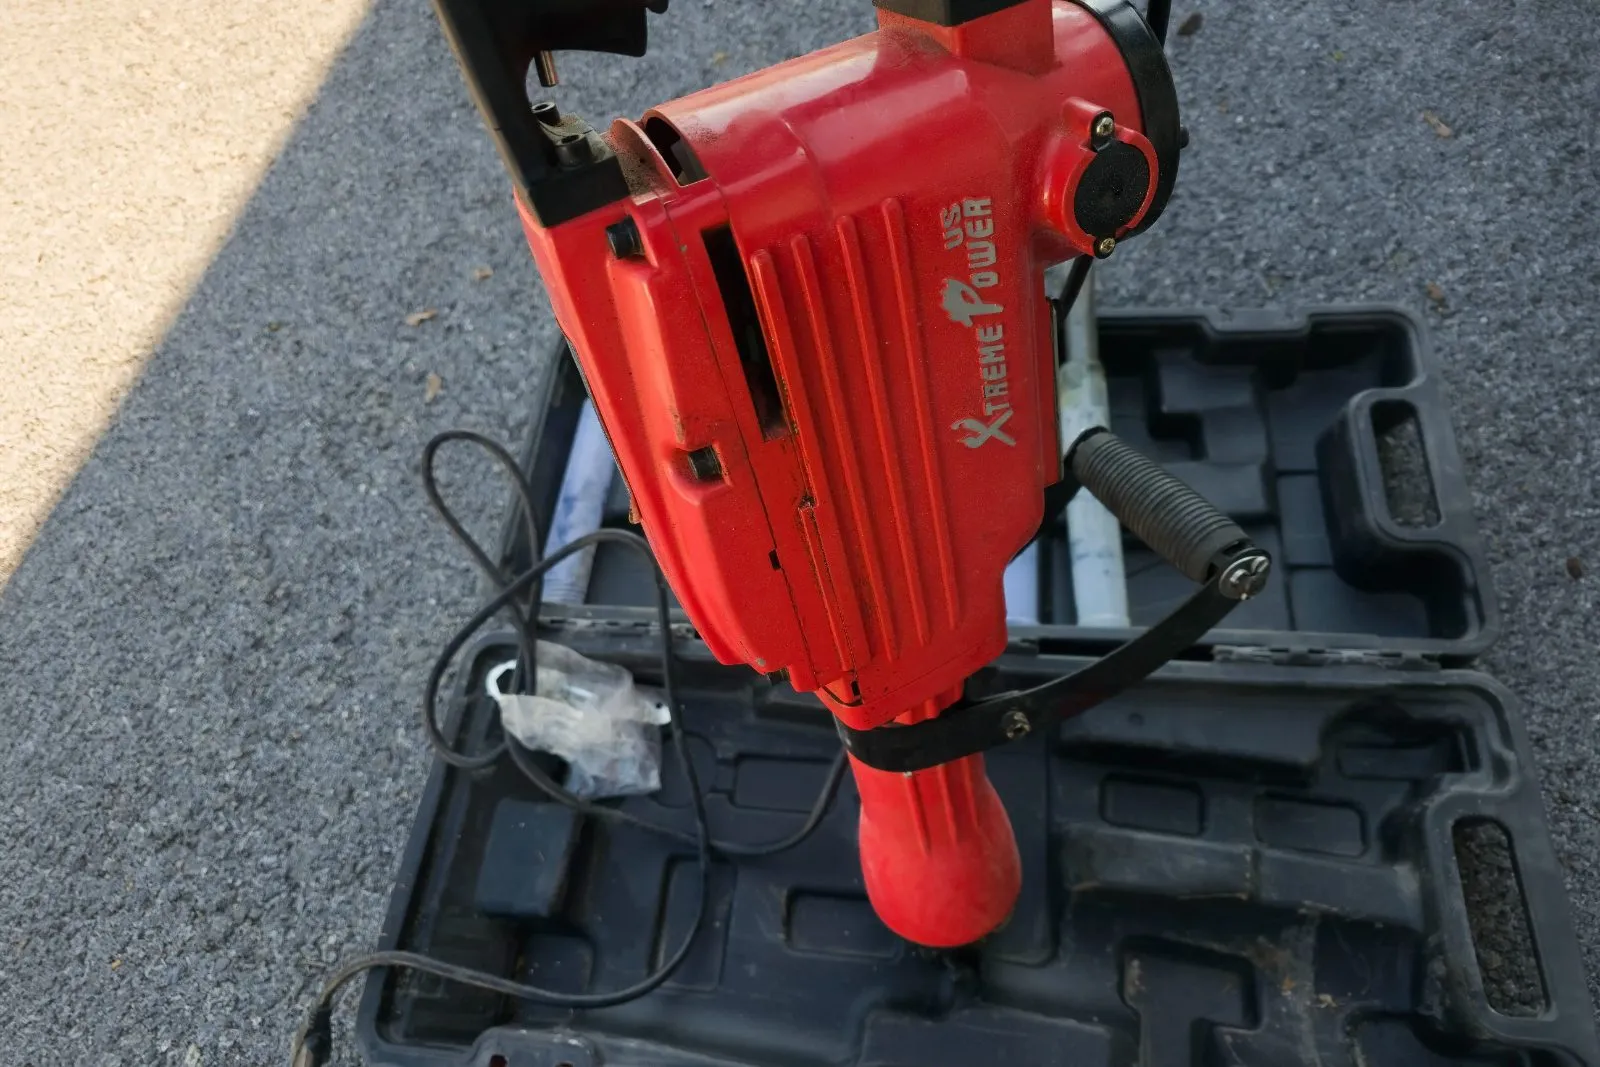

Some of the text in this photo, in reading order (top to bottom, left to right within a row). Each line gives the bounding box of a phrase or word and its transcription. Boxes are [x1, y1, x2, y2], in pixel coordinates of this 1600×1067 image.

[942, 203, 962, 250] US
[941, 197, 1016, 448] XTREME POWER
